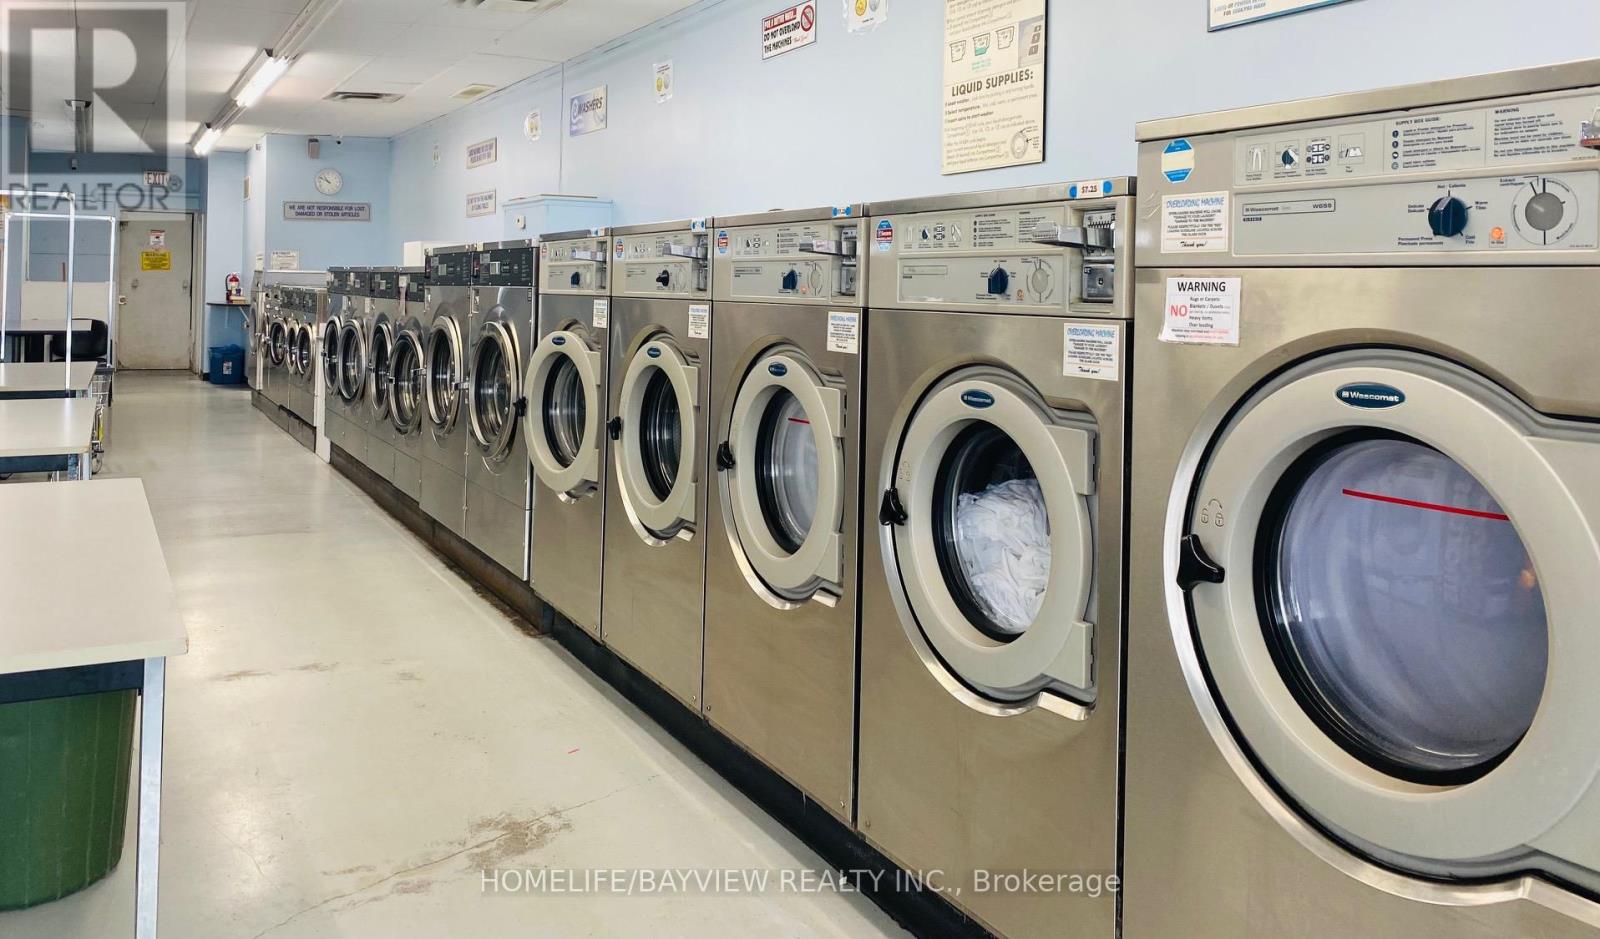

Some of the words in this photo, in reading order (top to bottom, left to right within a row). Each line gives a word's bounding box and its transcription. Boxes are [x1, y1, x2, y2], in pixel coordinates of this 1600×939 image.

[952, 80, 982, 96] LIQUID
[986, 69, 1034, 89] SUPPLIES:
[578, 96, 602, 114] WASHERS
[147, 172, 165, 184] EXIT
[1081, 185, 1097, 193] $7.25
[1177, 282, 1226, 292] WARNING
[1170, 305, 1188, 316] NO
[1350, 392, 1399, 402] Wascomat
